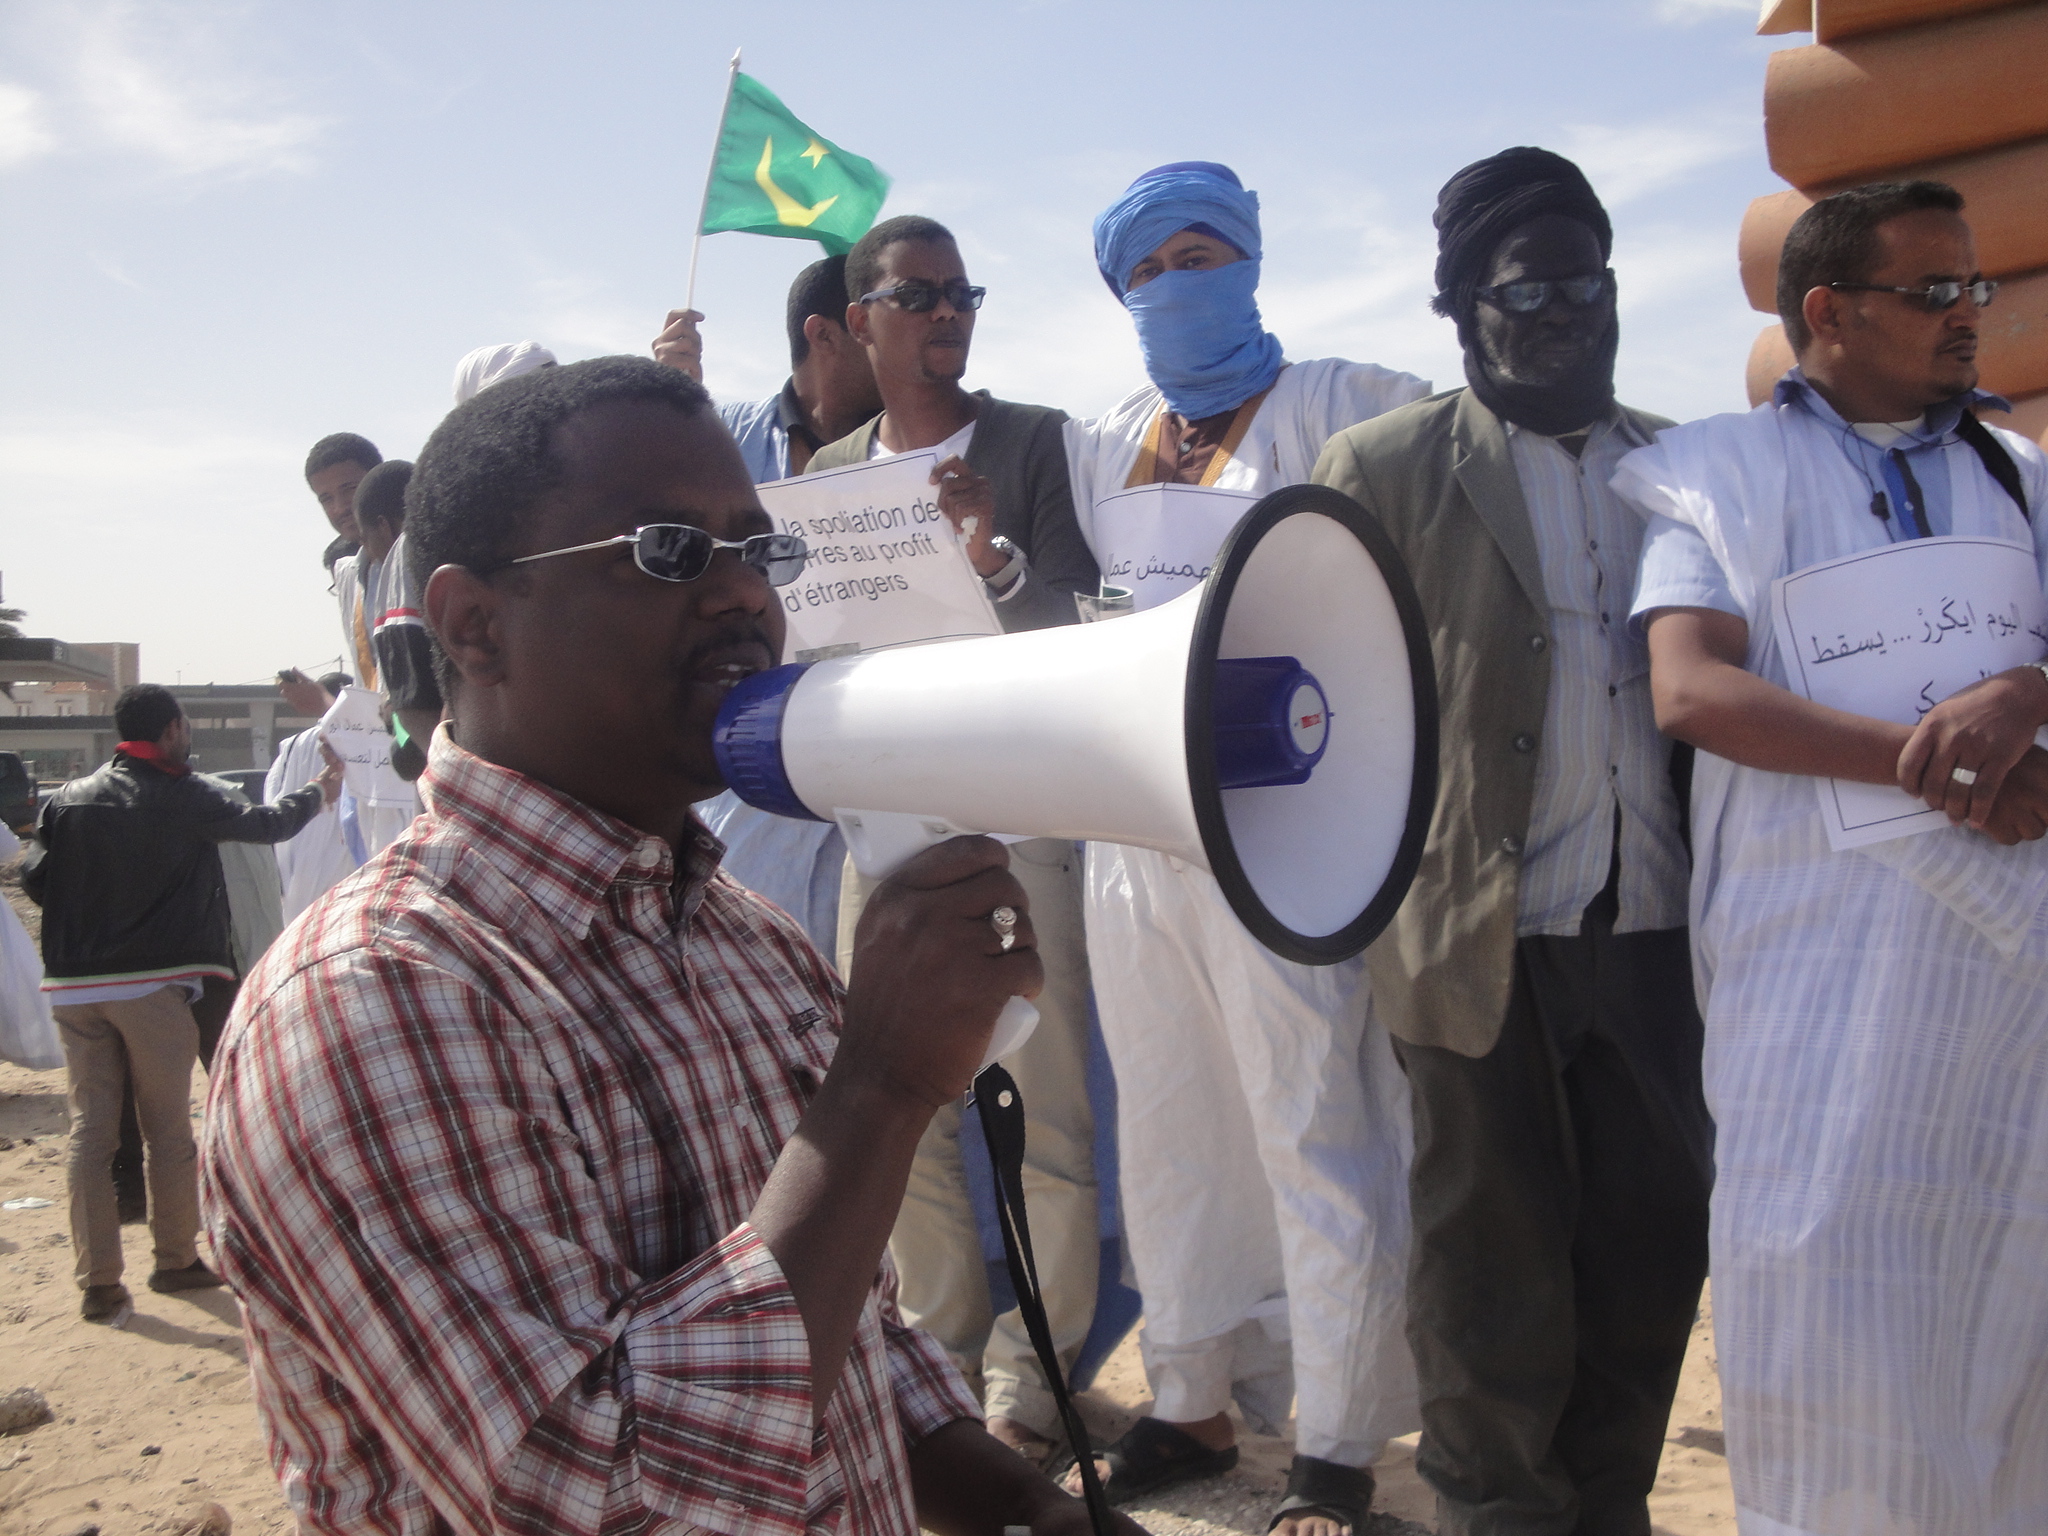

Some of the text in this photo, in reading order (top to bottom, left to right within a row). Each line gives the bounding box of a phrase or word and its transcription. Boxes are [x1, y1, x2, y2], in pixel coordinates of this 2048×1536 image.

[780, 517, 808, 539] la
[808, 504, 907, 539] spoliation
[850, 543, 878, 562] au
[878, 532, 939, 565] profit
[783, 571, 909, 613] d'étrangers
[1811, 630, 1888, 664] يسقط
